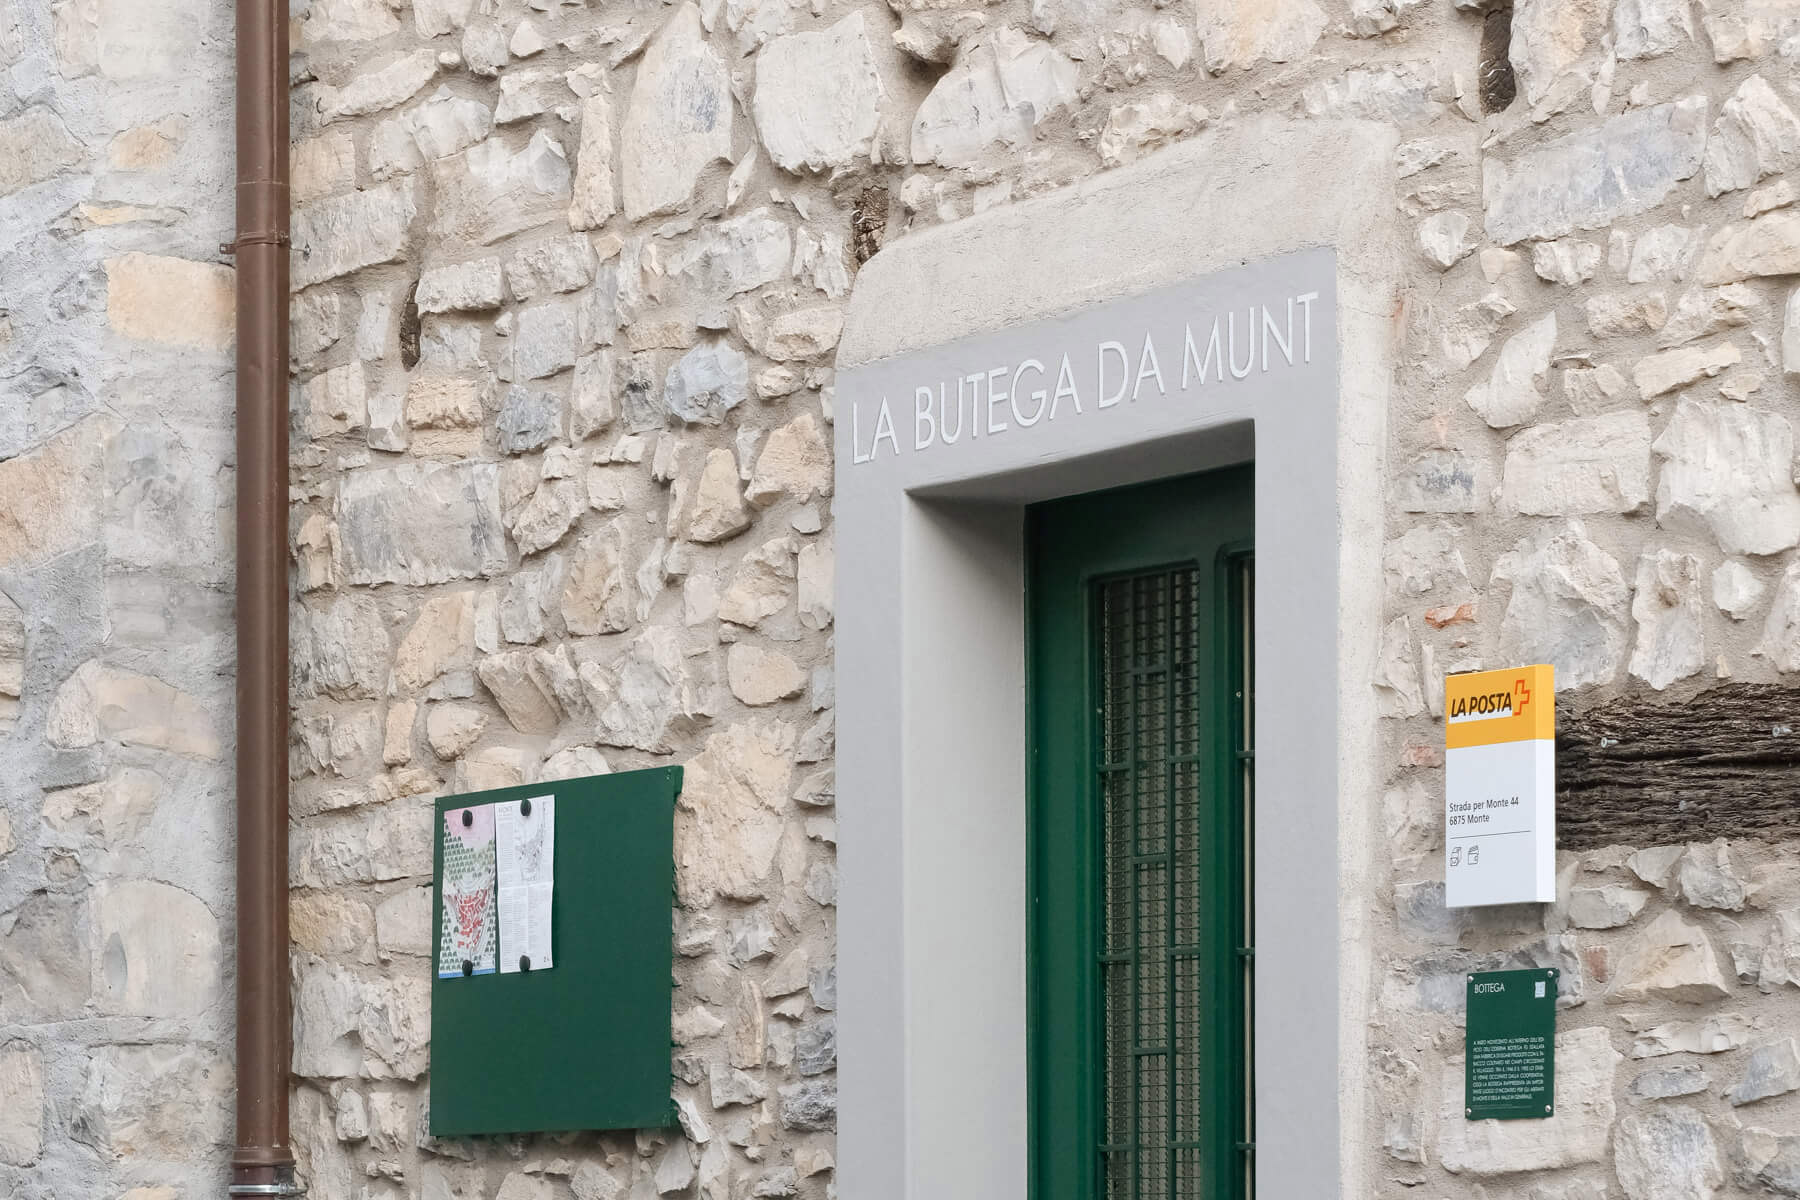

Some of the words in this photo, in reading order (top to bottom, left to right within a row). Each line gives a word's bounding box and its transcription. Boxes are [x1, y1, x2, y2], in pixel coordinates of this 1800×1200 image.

[852, 395, 900, 465] LA
[914, 351, 1082, 451] BUTEGA
[1098, 330, 1166, 409] DA
[1181, 291, 1319, 391] MUNT
[1450, 697, 1466, 718] LA
[1468, 691, 1512, 716] POSTA
[1449, 800, 1472, 813] Strada
[1472, 801, 1485, 812] per
[1486, 798, 1509, 809] Monte
[1510, 796, 1519, 806] 44
[1449, 815, 1466, 826] 6875
[1467, 814, 1490, 824] Monte
[1474, 982, 1505, 994] BOTTEGA
